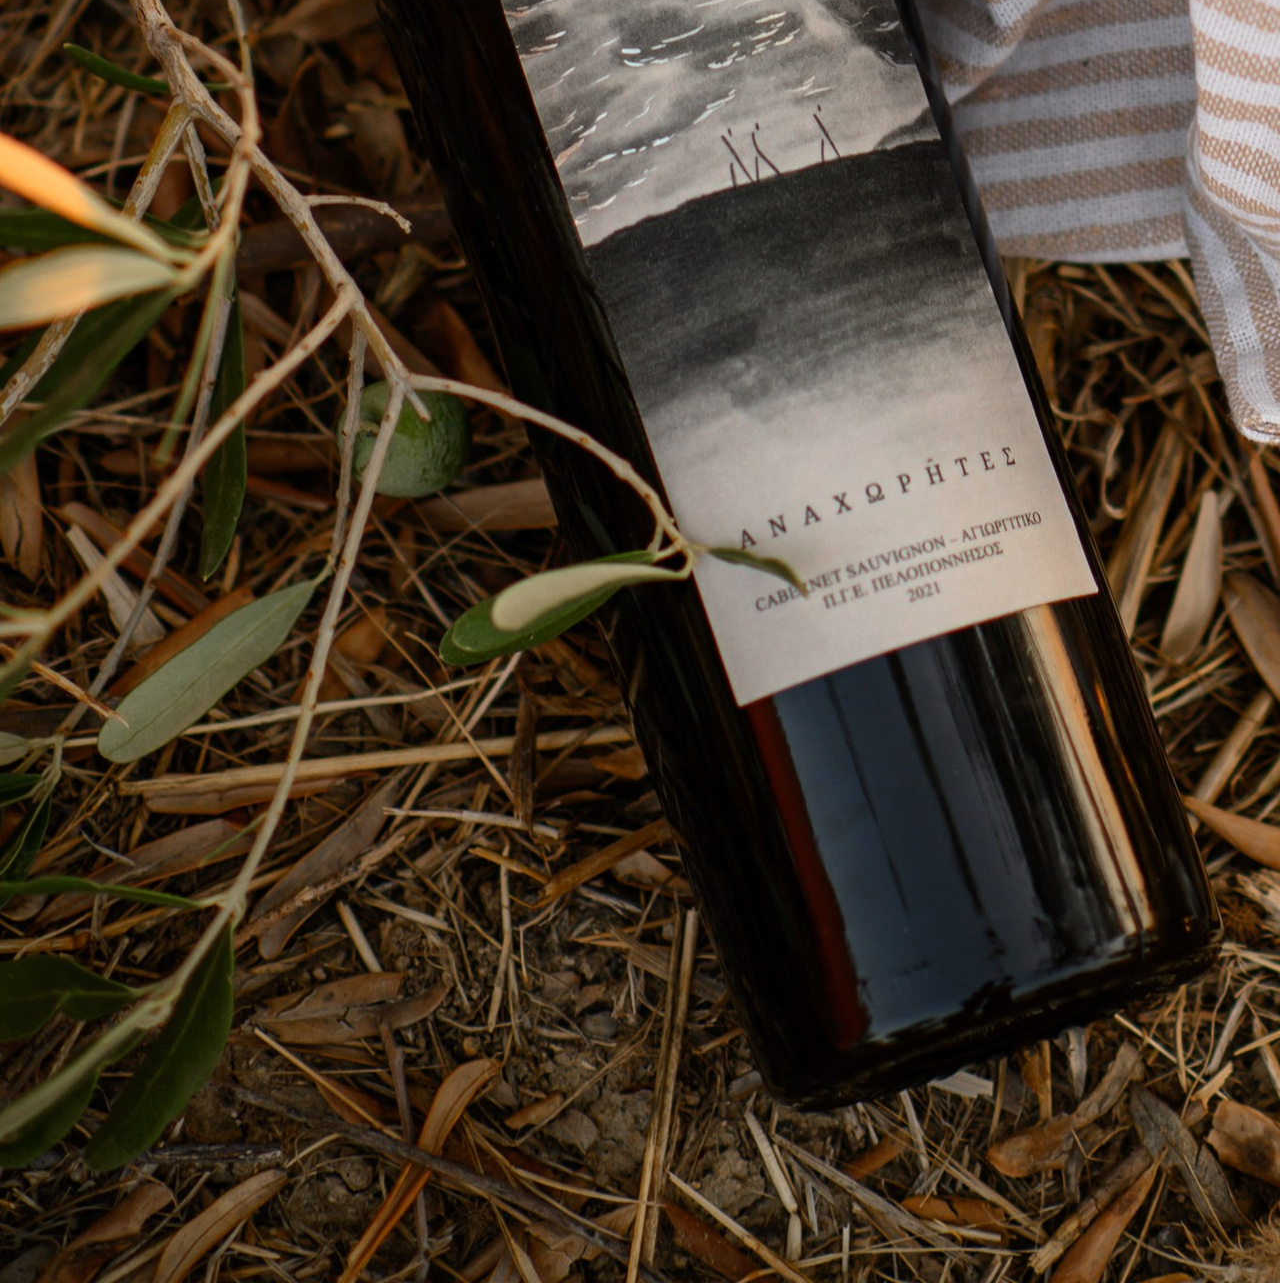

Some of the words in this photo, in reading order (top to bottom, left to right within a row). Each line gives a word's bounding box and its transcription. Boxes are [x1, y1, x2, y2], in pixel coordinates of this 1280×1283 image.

[755, 568, 843, 612] CABENET
[846, 535, 947, 579] SAUVIGNON
[961, 511, 1042, 543] ΑΓΙΩΡΓΙΤΙΚΟ
[870, 541, 1004, 592] ΠΕΛΟΠΟΝΝΗΣΟΣ
[906, 581, 941, 603] 2021
